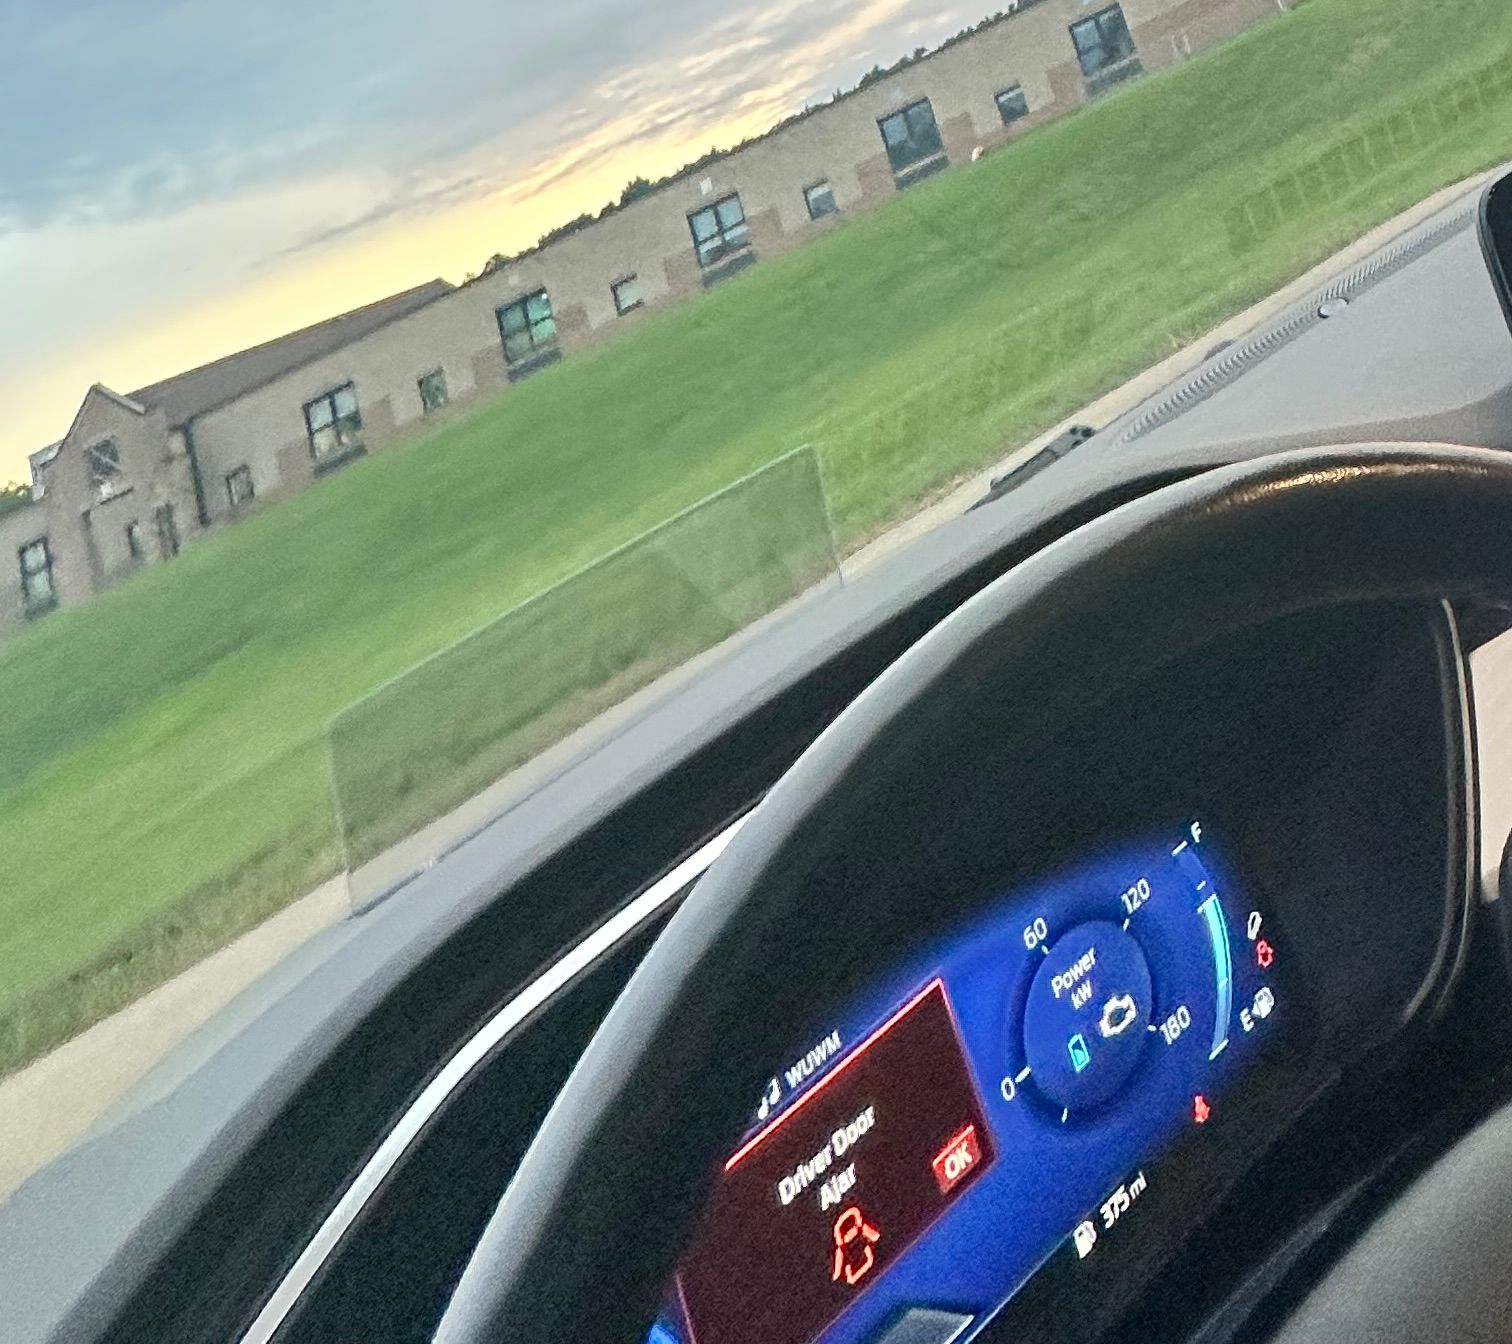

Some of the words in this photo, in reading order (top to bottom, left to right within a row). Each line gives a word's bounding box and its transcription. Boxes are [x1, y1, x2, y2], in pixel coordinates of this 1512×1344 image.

[1190, 821, 1202, 843] F
[1120, 877, 1151, 914] 120
[1023, 917, 1048, 950] 60
[1051, 946, 1097, 999] Power
[1070, 979, 1092, 1010] kW
[1159, 1004, 1192, 1045] 180
[1239, 1007, 1254, 1032] E
[784, 1028, 842, 1089] WUWM
[1000, 1076, 1015, 1101] 0
[777, 1143, 833, 1206] Driver
[831, 1104, 877, 1157] Door
[944, 1141, 973, 1180] OK
[818, 1162, 857, 1211] Ajar
[1100, 1183, 1130, 1229] 375
[1129, 1171, 1147, 1200] mi
